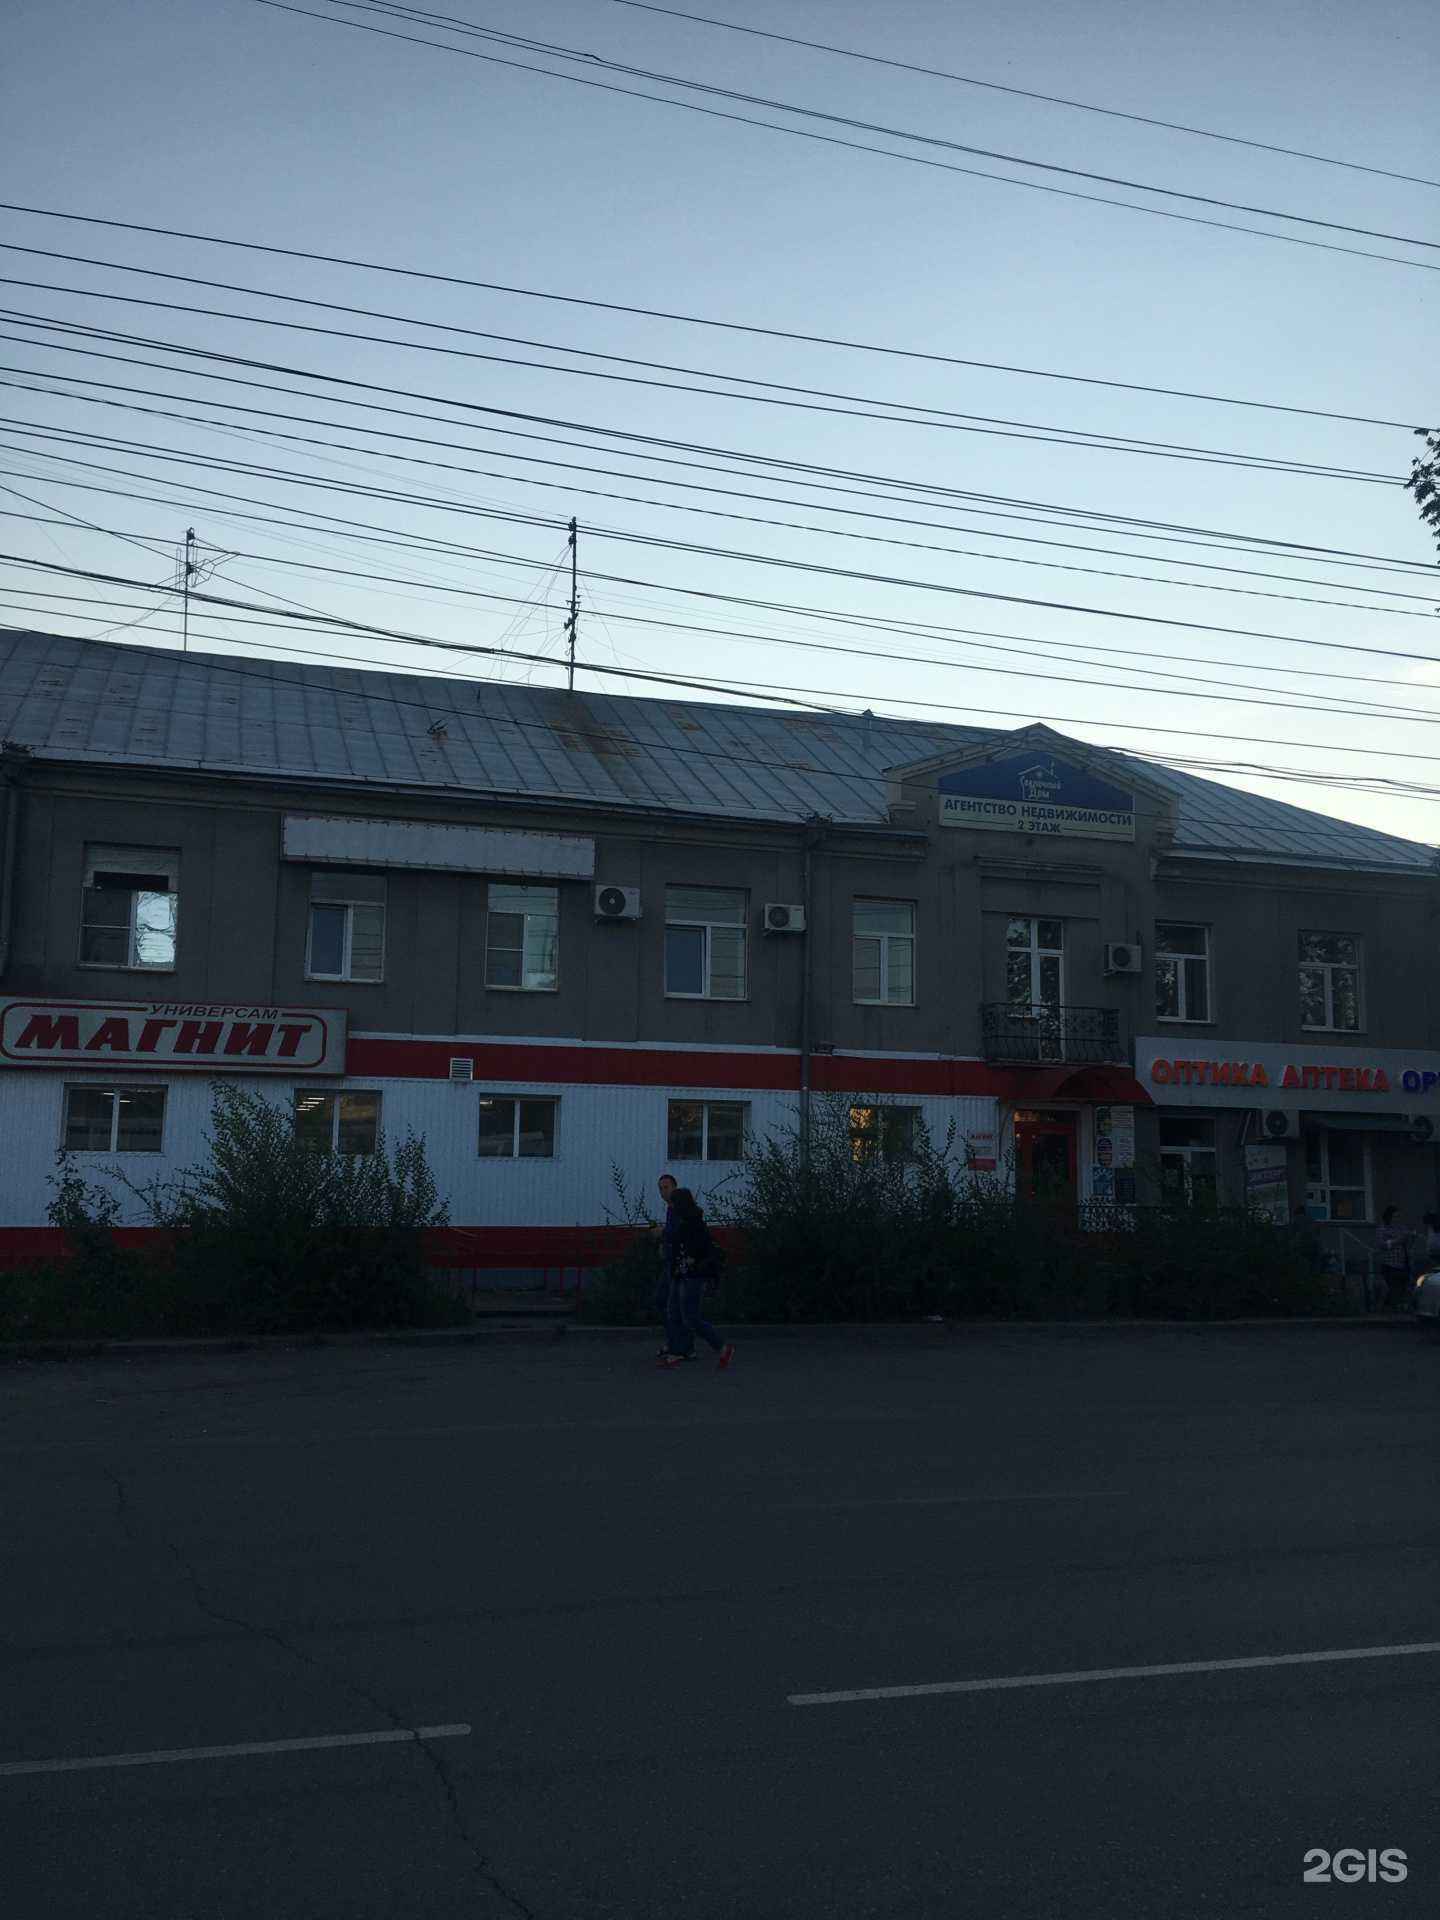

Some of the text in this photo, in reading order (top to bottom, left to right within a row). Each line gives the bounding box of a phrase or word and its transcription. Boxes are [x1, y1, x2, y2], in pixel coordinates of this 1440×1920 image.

[944, 799, 1131, 826] АГЕНТСТВО НЕДВИЖИМОСТИ
[1018, 820, 1061, 833] 2 ЭТАЖ
[150, 1004, 278, 1020] УНИВЕРСАМ
[14, 1014, 312, 1057] МАГНИТ
[1151, 1058, 1440, 1094] ОПТИКА АПТЕКА ОР
